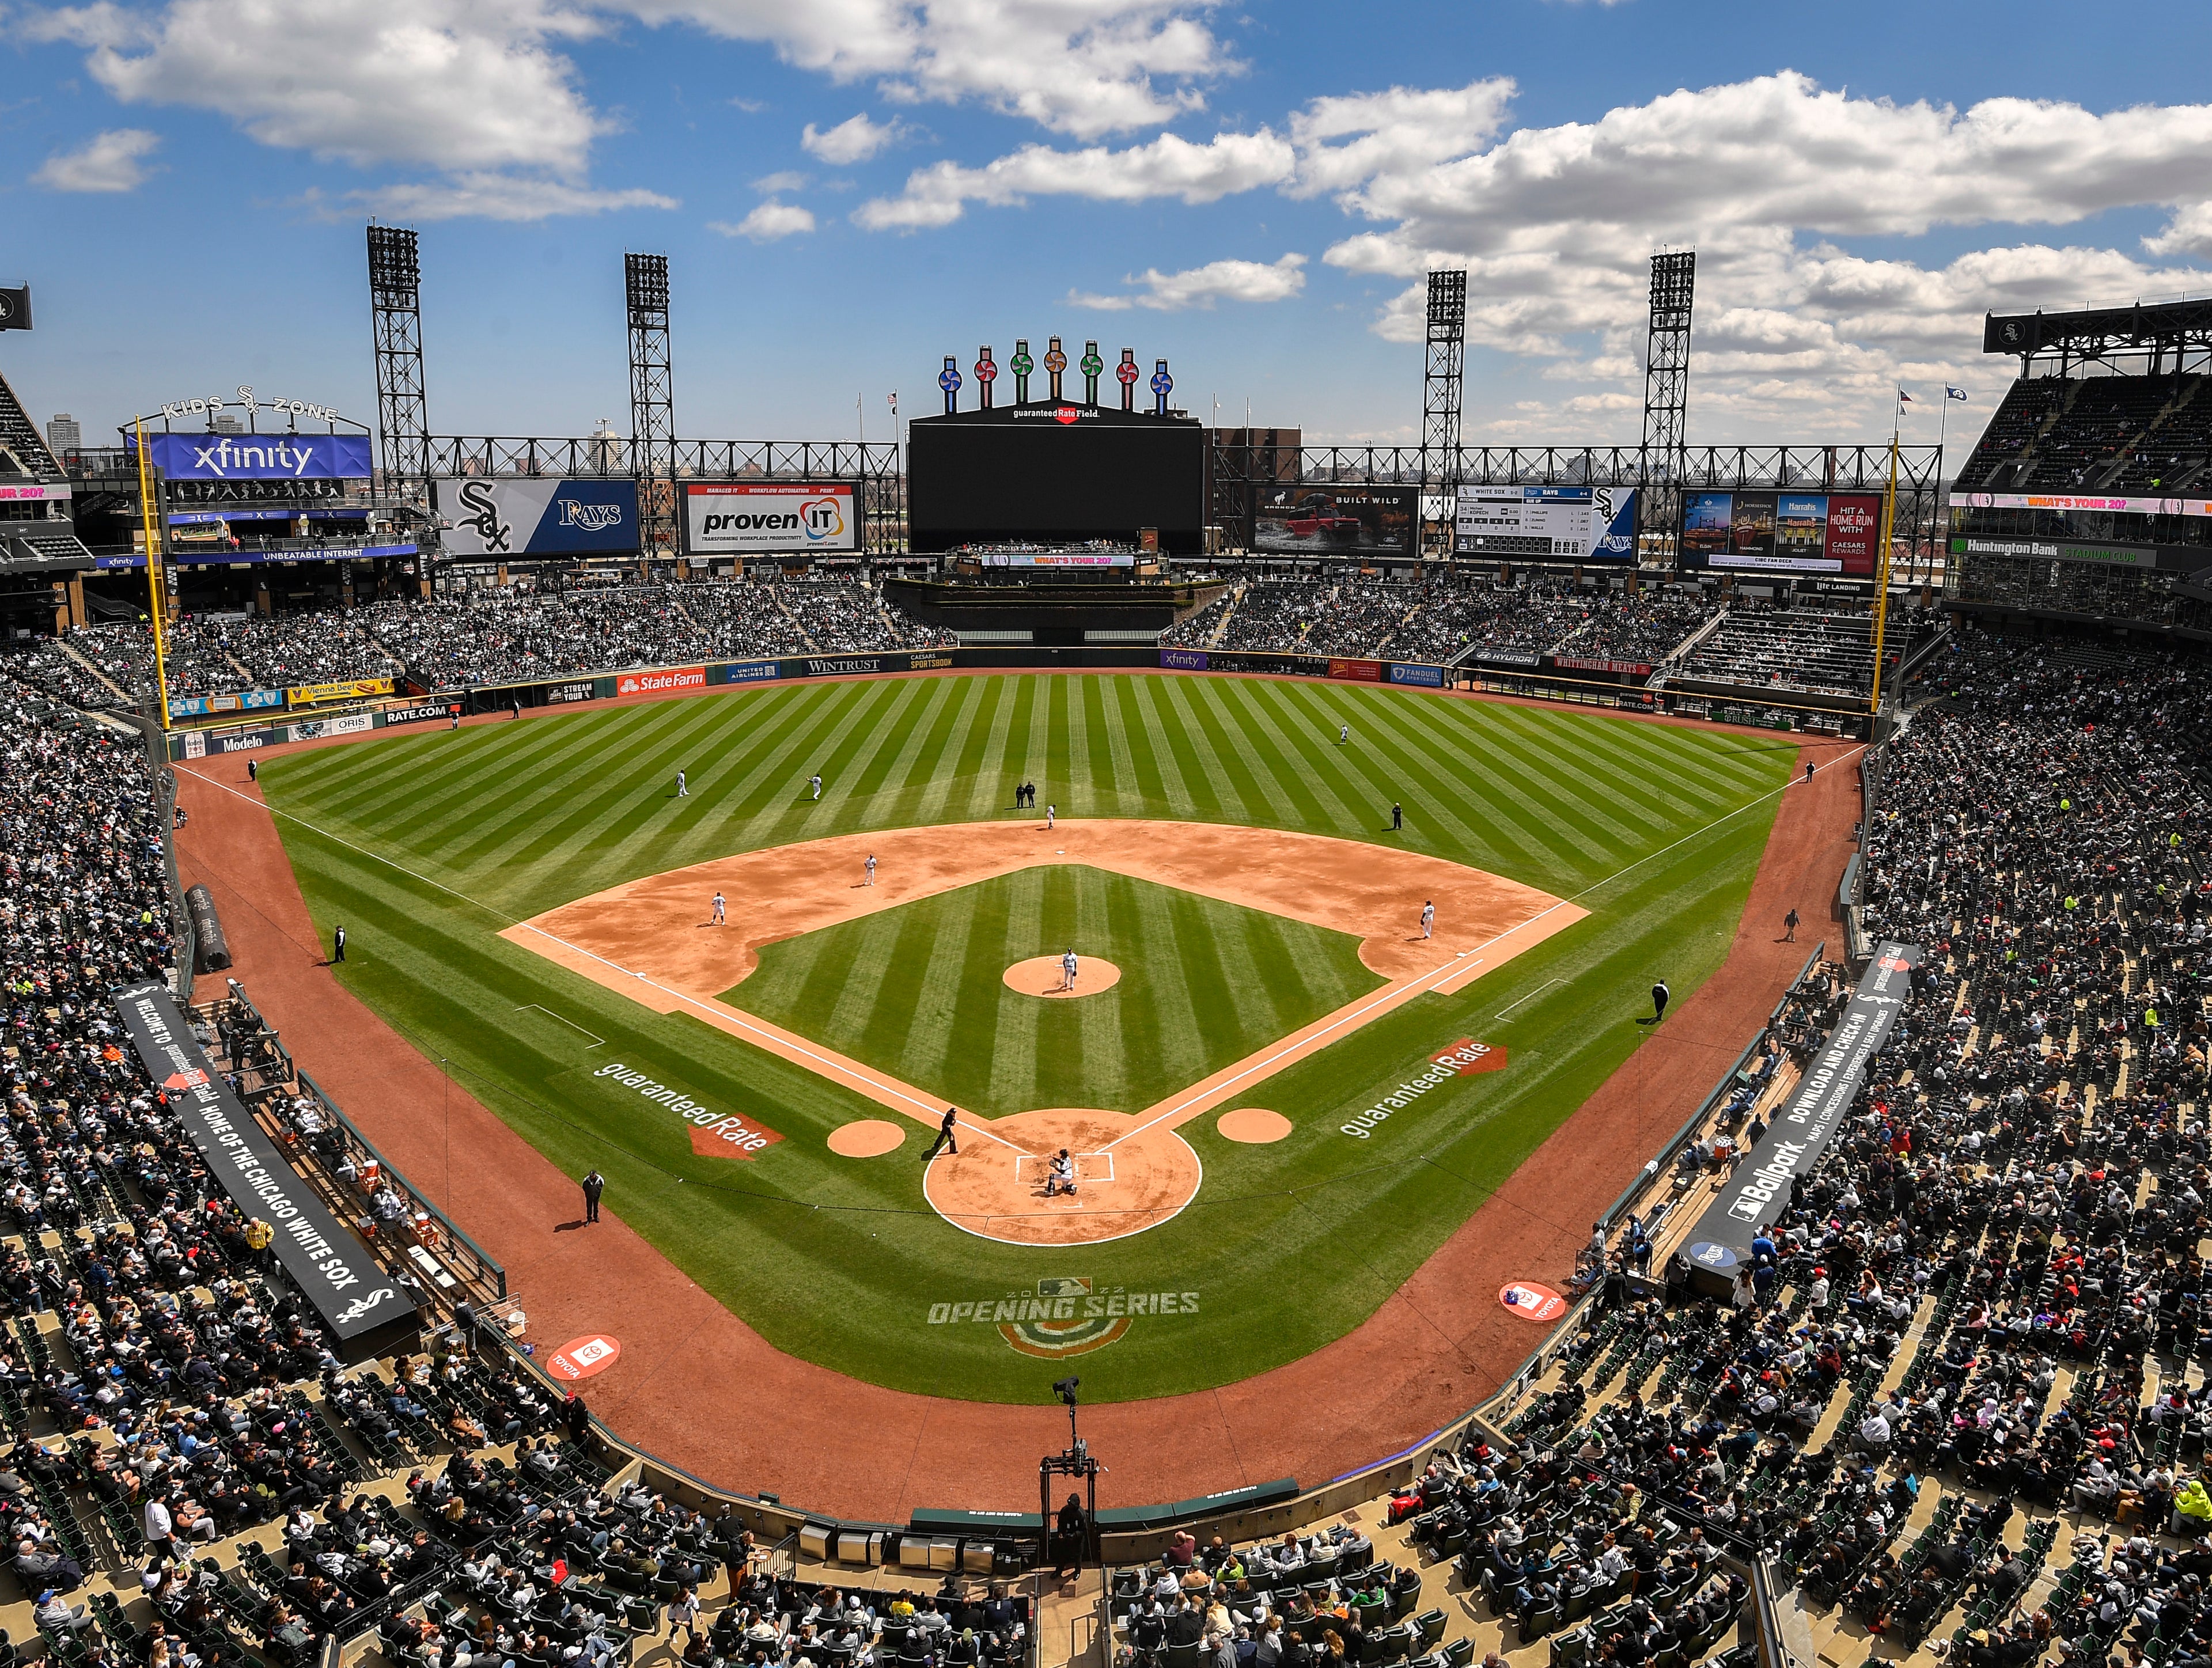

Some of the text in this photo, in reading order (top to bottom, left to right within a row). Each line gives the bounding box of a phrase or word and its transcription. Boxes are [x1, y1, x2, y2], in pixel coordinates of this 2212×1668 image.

[161, 396, 339, 423] KIDS ZONE
[194, 438, 313, 476] xfinity
[20, 487, 44, 498] 20?
[2028, 497, 2127, 509] WHAT'S YOUR 20?
[703, 510, 832, 534] proven IT
[1830, 514, 1873, 526] HOME RUN
[263, 549, 363, 560] UNBEATABLE INTERNET
[1968, 540, 2058, 556] Huntington Bank
[1034, 556, 1069, 564] WHAT'S
[2065, 548, 2136, 562] STADIUM CLUB
[108, 558, 134, 566] xfinity
[1816, 582, 1830, 590] Lite
[911, 658, 953, 669] SPORTSBOOK
[1165, 654, 1199, 667] xfinity
[1493, 653, 1535, 664] HYUNDAI
[1556, 657, 1608, 671] WHITTINGHAM
[1612, 662, 1637, 673] MEATS
[808, 659, 880, 672] WINTRUST
[1407, 669, 1439, 678] FANDUEL
[563, 683, 592, 693] STREAM
[564, 692, 582, 701] YOUR
[1619, 700, 1654, 710] RATE.COM
[387, 706, 446, 723] RATE.COM
[1733, 715, 1756, 725] RUSH
[339, 718, 365, 728] ORIS
[224, 736, 263, 752] Modelo
[1806, 1009, 1889, 1142] MAPS CONCESSIONS EXPERIENCES & SEAT UPGRADES
[1787, 1068, 1834, 1124] DOWNLOAD
[1822, 1049, 1846, 1070] AND
[135, 998, 360, 1292] WELCOME TO Field HOME OF THE CHICAGO WHITE SOX
[927, 1291, 1200, 1325] OPENING SERIES
[1535, 1297, 1561, 1318] TOYOTA
[552, 1355, 580, 1378] TOYOTA
